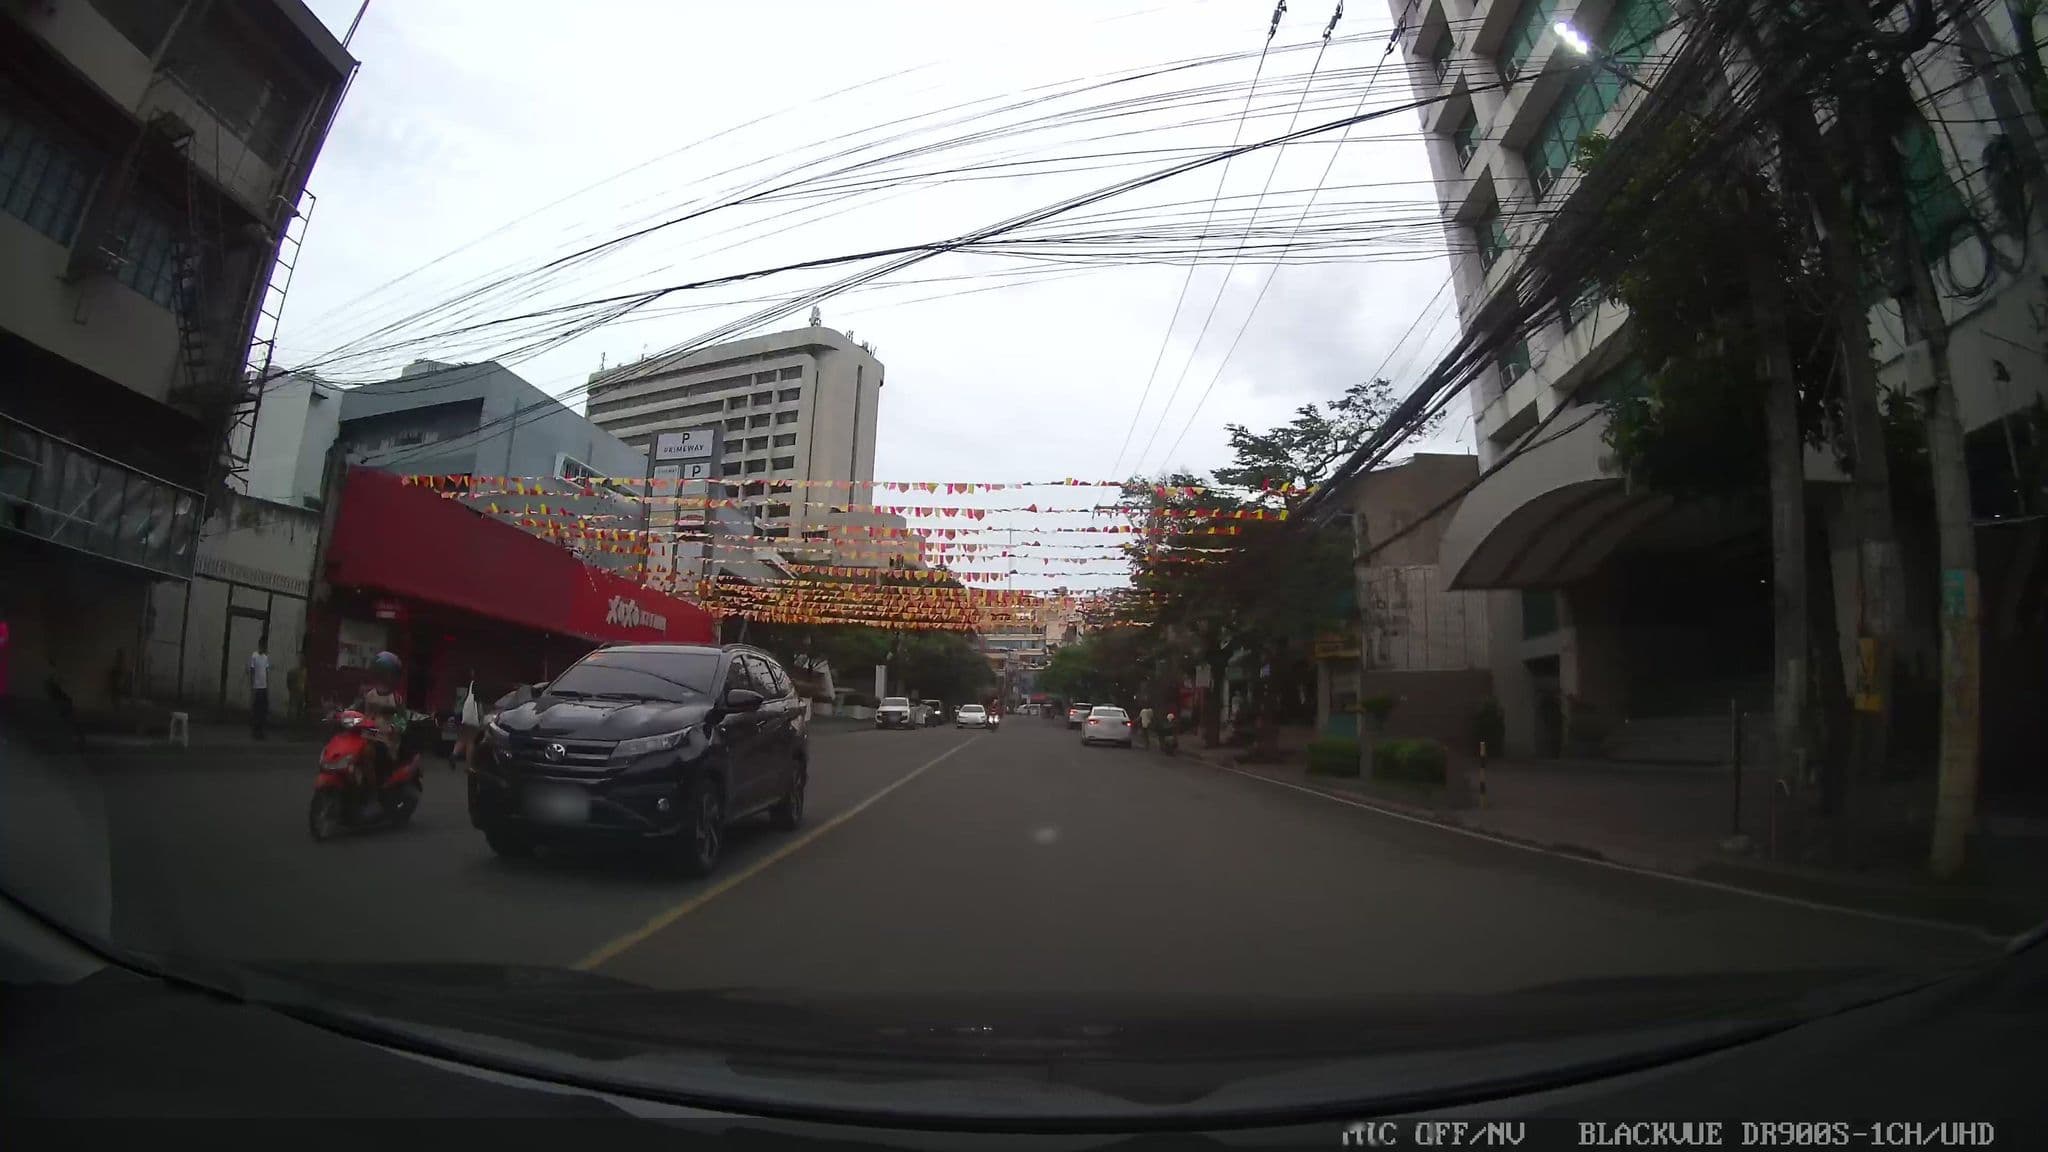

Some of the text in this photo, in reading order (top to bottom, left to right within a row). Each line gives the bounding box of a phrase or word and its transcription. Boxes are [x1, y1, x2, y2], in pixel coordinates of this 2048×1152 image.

[682, 433, 690, 444] P
[664, 445, 704, 453] PRIMEWAY
[692, 465, 701, 477] P
